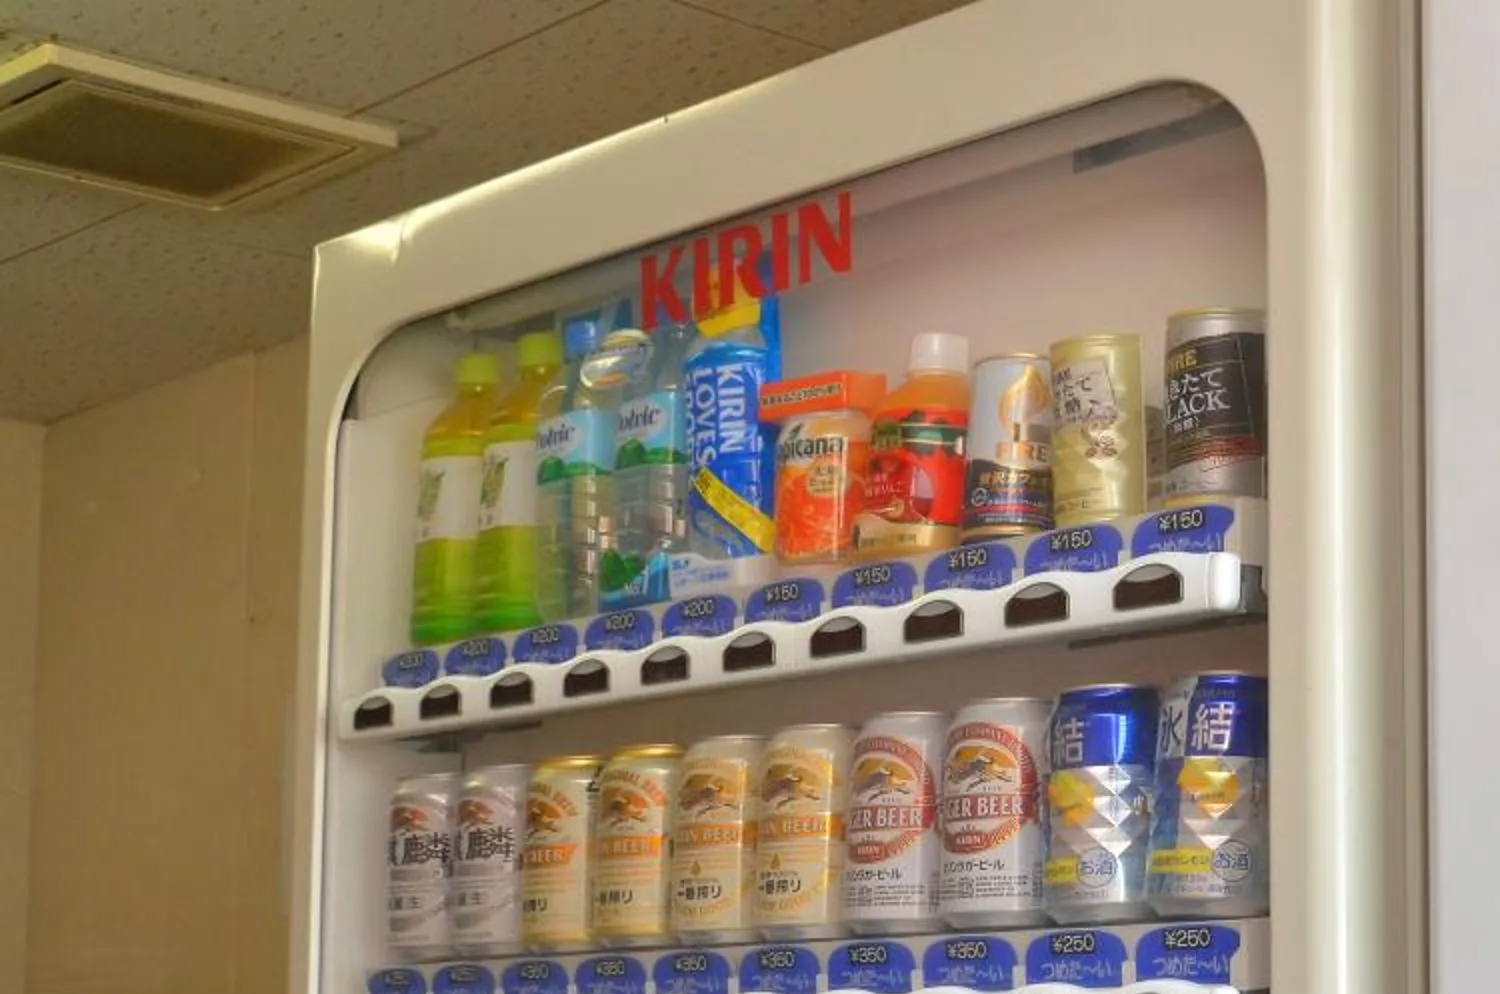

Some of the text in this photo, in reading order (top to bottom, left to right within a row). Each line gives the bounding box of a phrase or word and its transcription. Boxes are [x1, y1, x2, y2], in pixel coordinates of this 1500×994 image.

[639, 190, 853, 332] KIRIN
[716, 362, 745, 455] KIRIN
[1165, 388, 1232, 424] LACK
[1053, 718, 1085, 766] 結
[976, 792, 1024, 818] BEER
[876, 806, 922, 830] BEER
[1078, 859, 1114, 877] お酒
[1213, 849, 1251, 870] お酒
[1051, 932, 1096, 953] ¥250
[1164, 928, 1212, 948] ¥250
